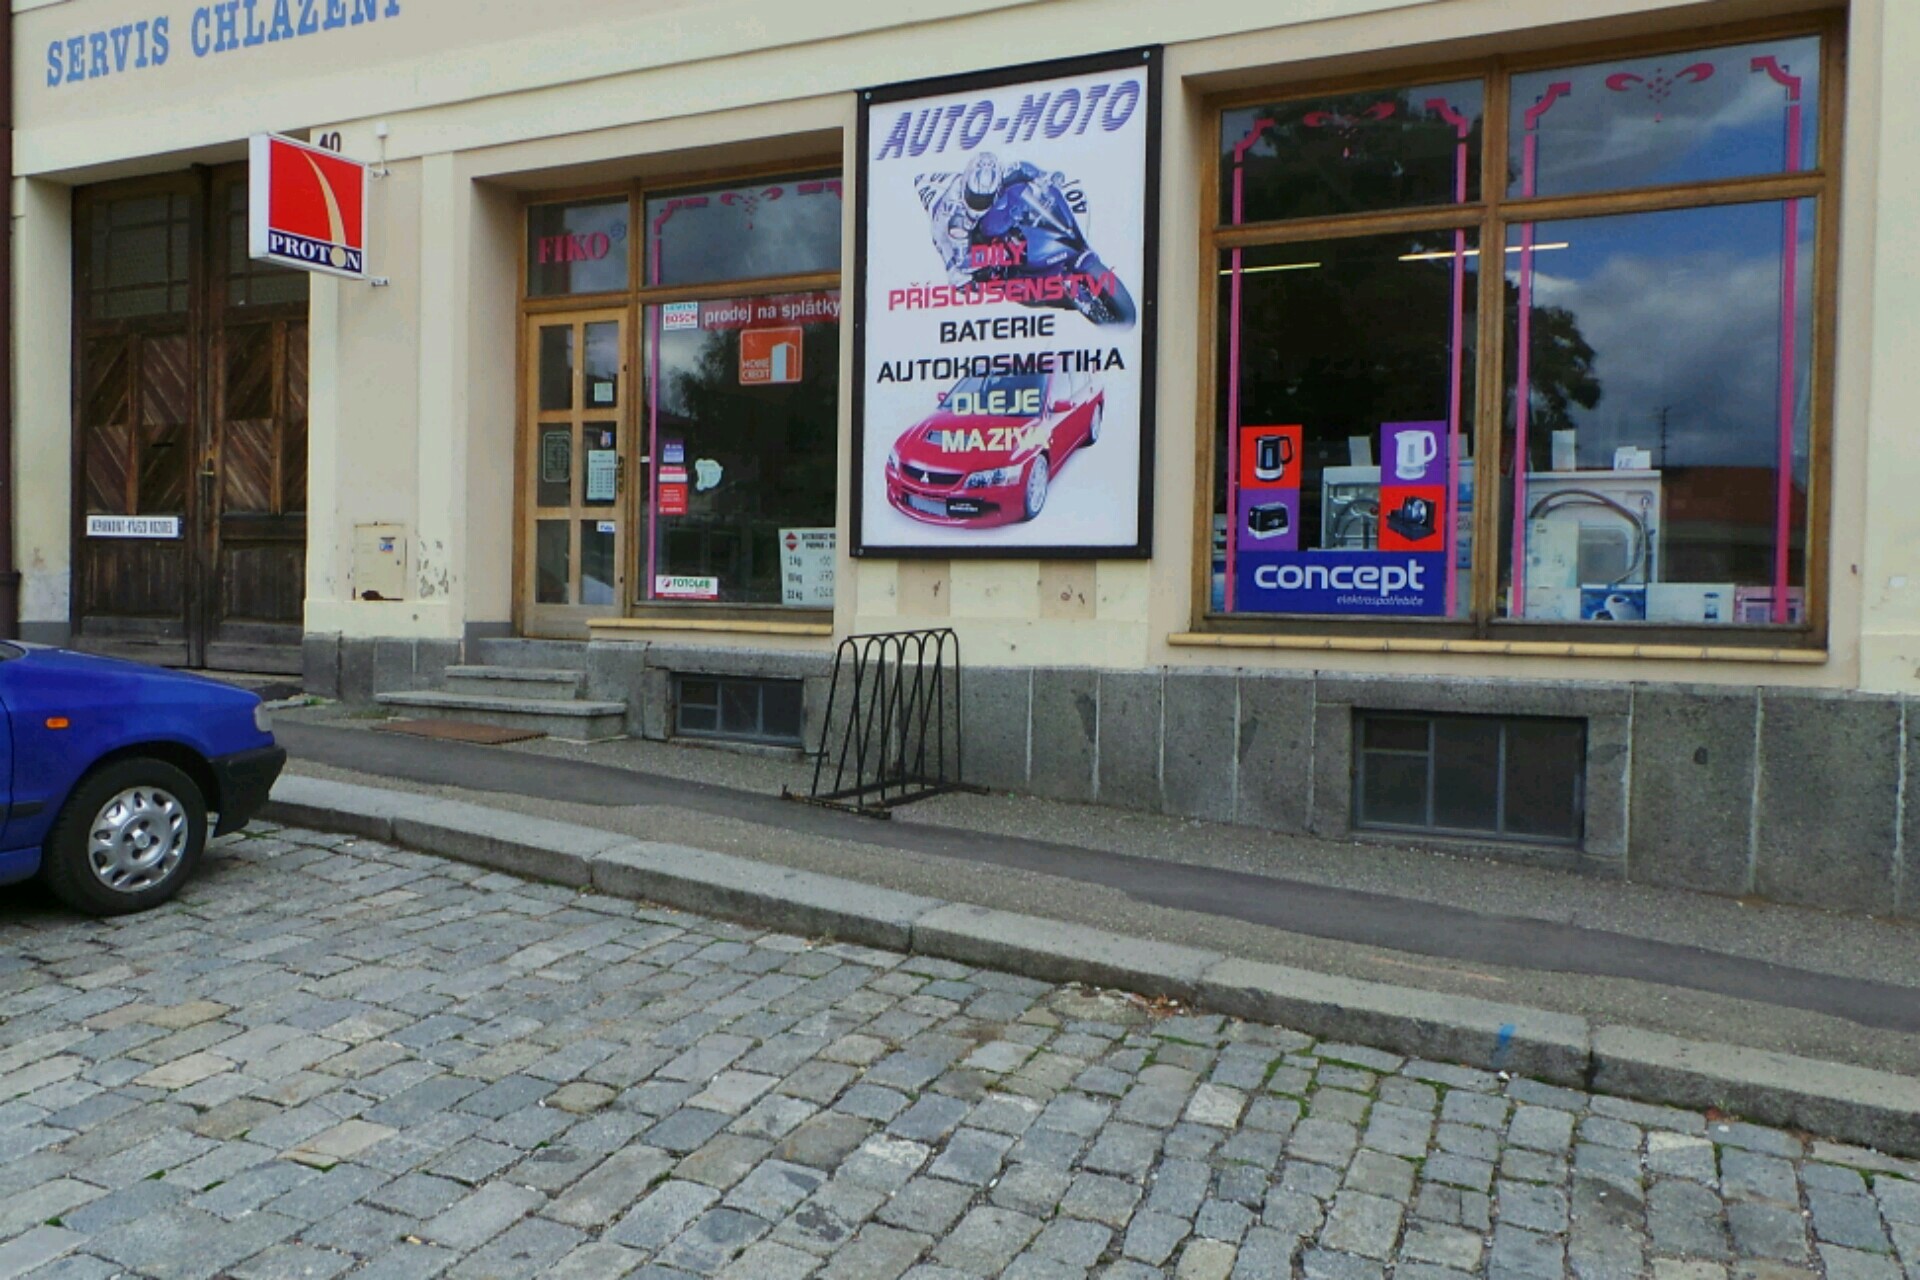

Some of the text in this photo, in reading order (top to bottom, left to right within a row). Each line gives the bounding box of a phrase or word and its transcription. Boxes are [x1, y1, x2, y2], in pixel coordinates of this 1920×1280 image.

[46, 15, 169, 88] SERVIS
[873, 80, 1141, 161] AUTO-MOTO
[269, 232, 362, 270] PROTON
[538, 231, 609, 265] FIKO
[971, 238, 1028, 268] DÍLY
[888, 266, 1117, 311] PŘÍSLUŠENSTVÍ
[704, 299, 842, 326] prodej na splátky
[940, 314, 1055, 344] BATERIE
[877, 347, 1125, 384] AUTOKOSMETIKA
[952, 388, 1040, 417] OLEJE
[941, 426, 1050, 453] MAZIVA
[1254, 558, 1425, 598] concept
